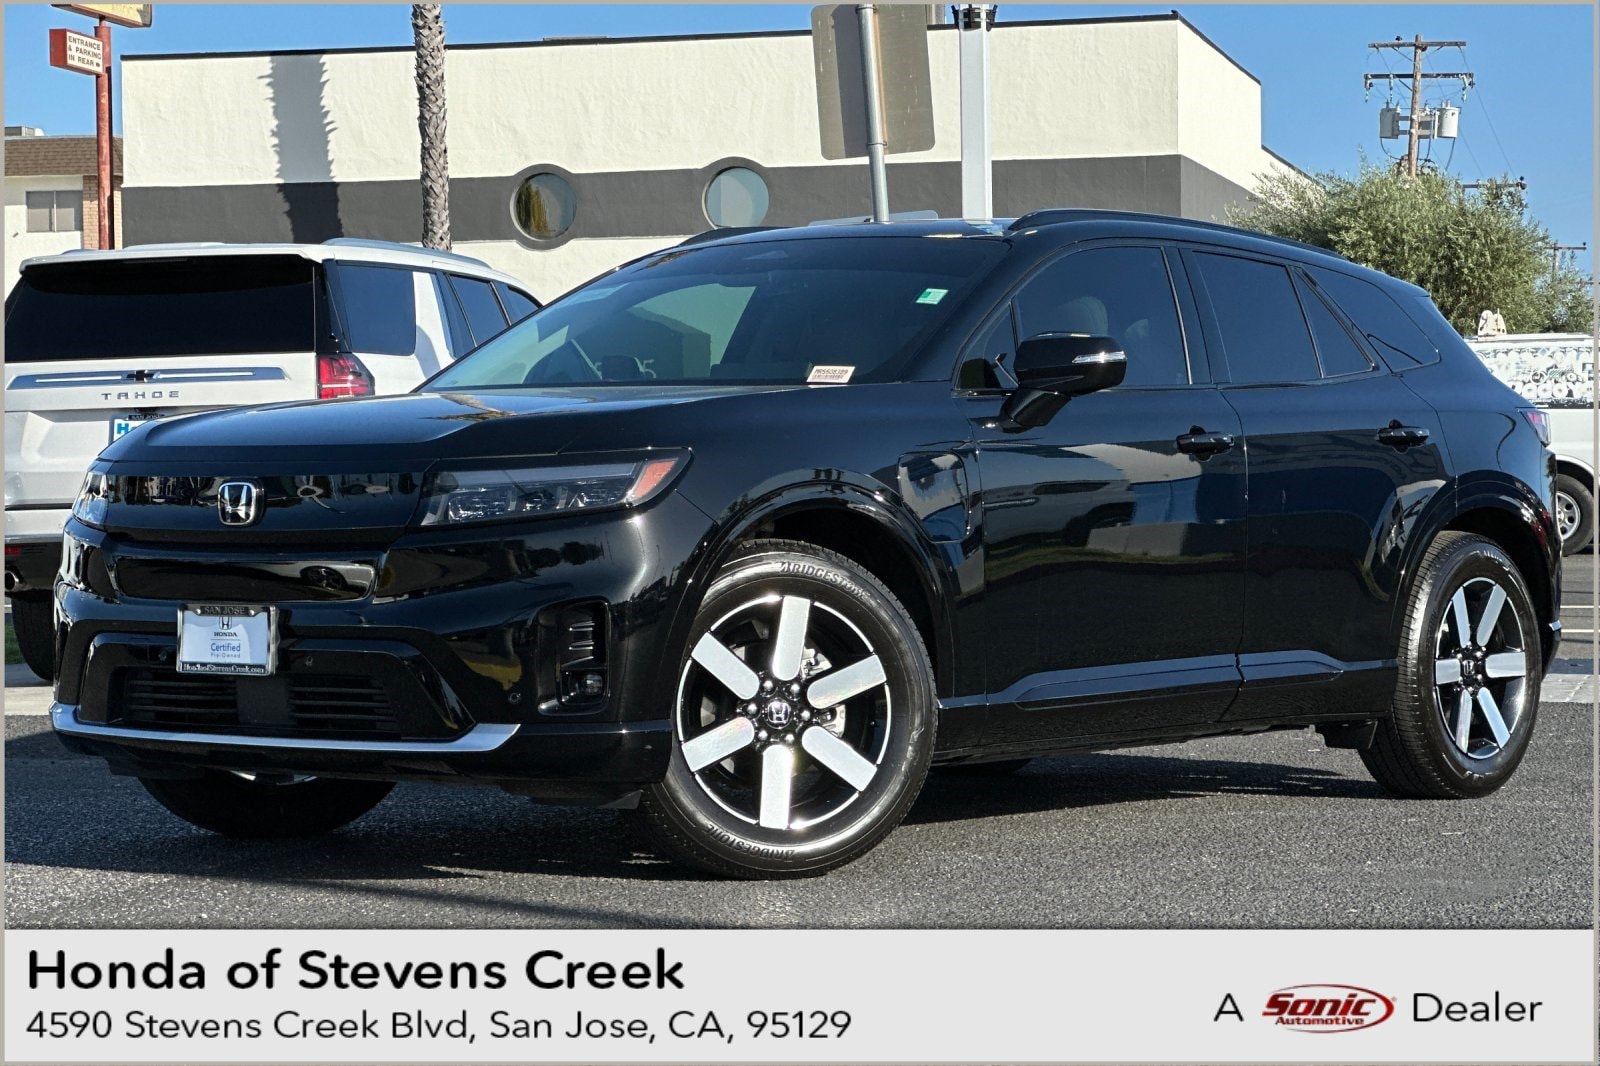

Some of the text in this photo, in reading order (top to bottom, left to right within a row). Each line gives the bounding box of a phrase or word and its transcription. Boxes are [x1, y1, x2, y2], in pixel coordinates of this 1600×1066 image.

[68, 36, 101, 51] ENTRANCE
[75, 47, 101, 60] PARKING
[77, 57, 94, 66] REAR
[101, 391, 179, 400] TAHOE
[204, 606, 246, 615] SAN JOSE
[211, 643, 241, 652] Certified
